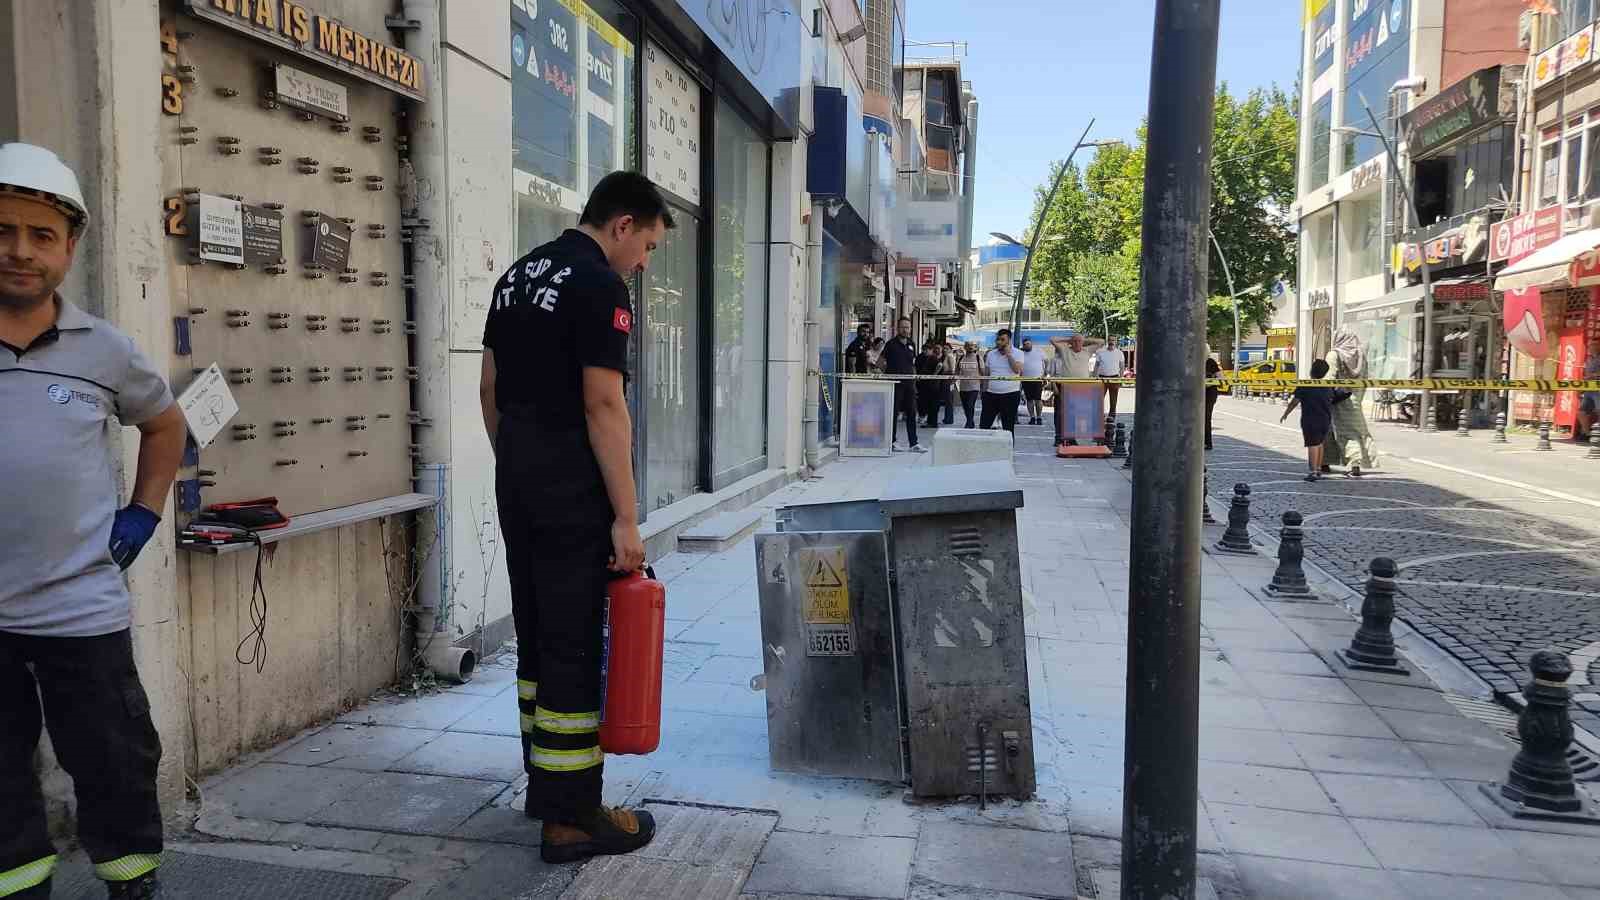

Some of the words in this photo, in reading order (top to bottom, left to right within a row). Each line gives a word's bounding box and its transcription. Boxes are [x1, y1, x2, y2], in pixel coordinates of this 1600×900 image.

[162, 76, 183, 115] 3
[659, 106, 676, 134] FLO
[163, 196, 190, 236] 2
